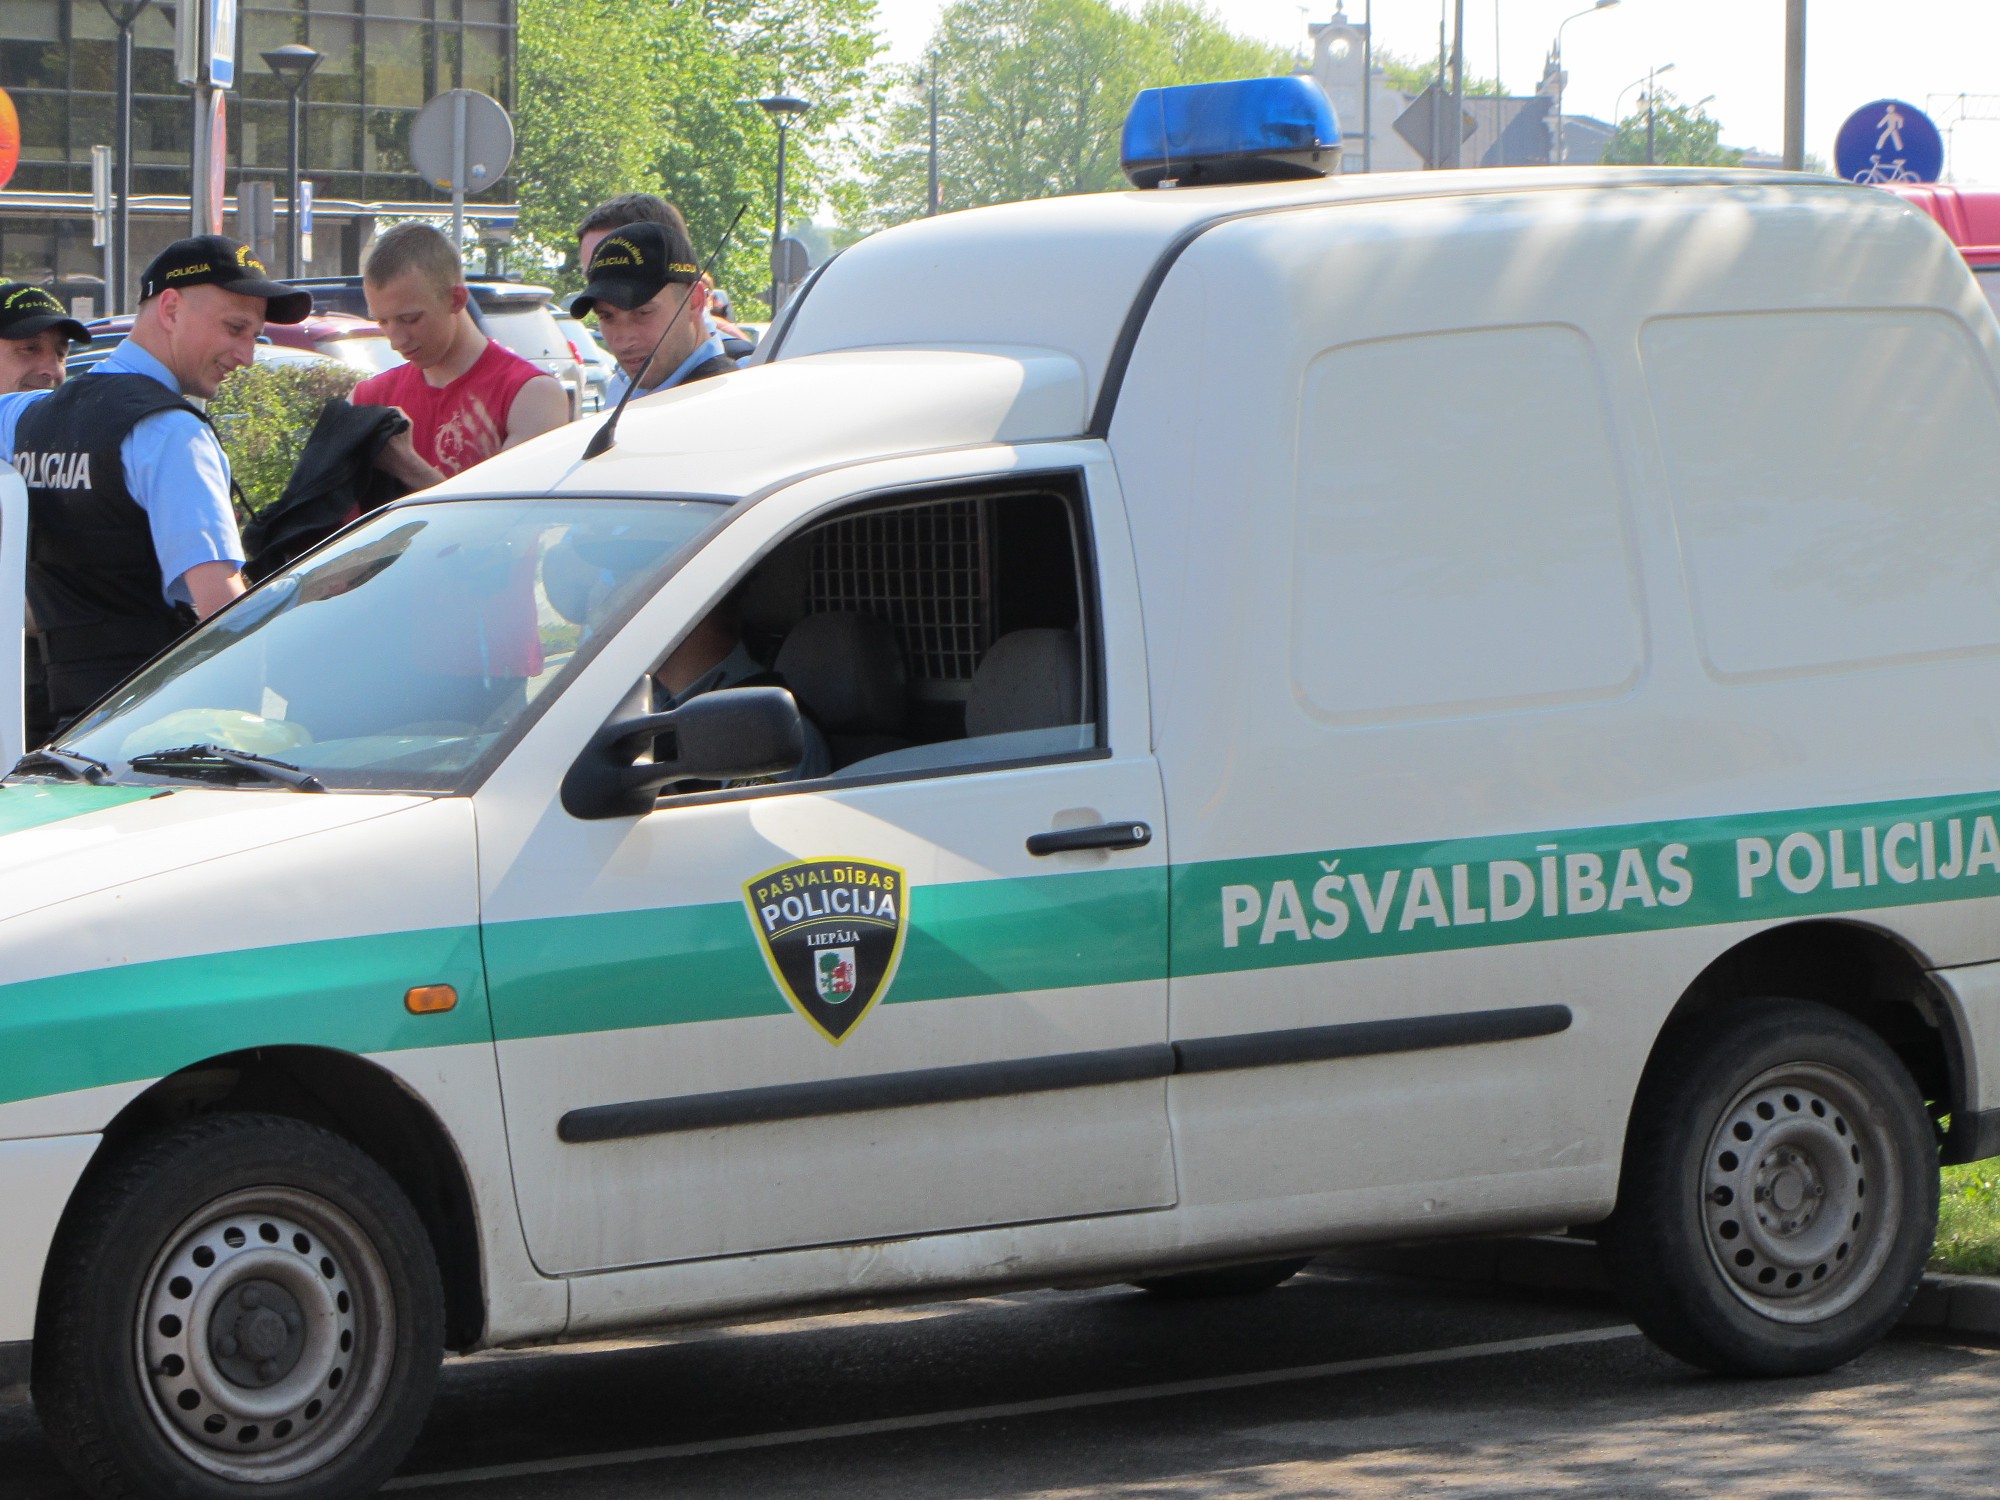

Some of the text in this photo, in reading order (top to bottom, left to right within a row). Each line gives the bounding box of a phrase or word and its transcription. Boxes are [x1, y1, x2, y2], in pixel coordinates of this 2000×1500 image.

[165, 263, 211, 279] POLICIJA
[757, 867, 895, 903] PAŠVALDĪBAS
[1221, 815, 2000, 948] PAŠVALDĪBAS POLICIJA
[761, 888, 897, 931] POLICIJA
[807, 929, 861, 946] LIEPĀJA
